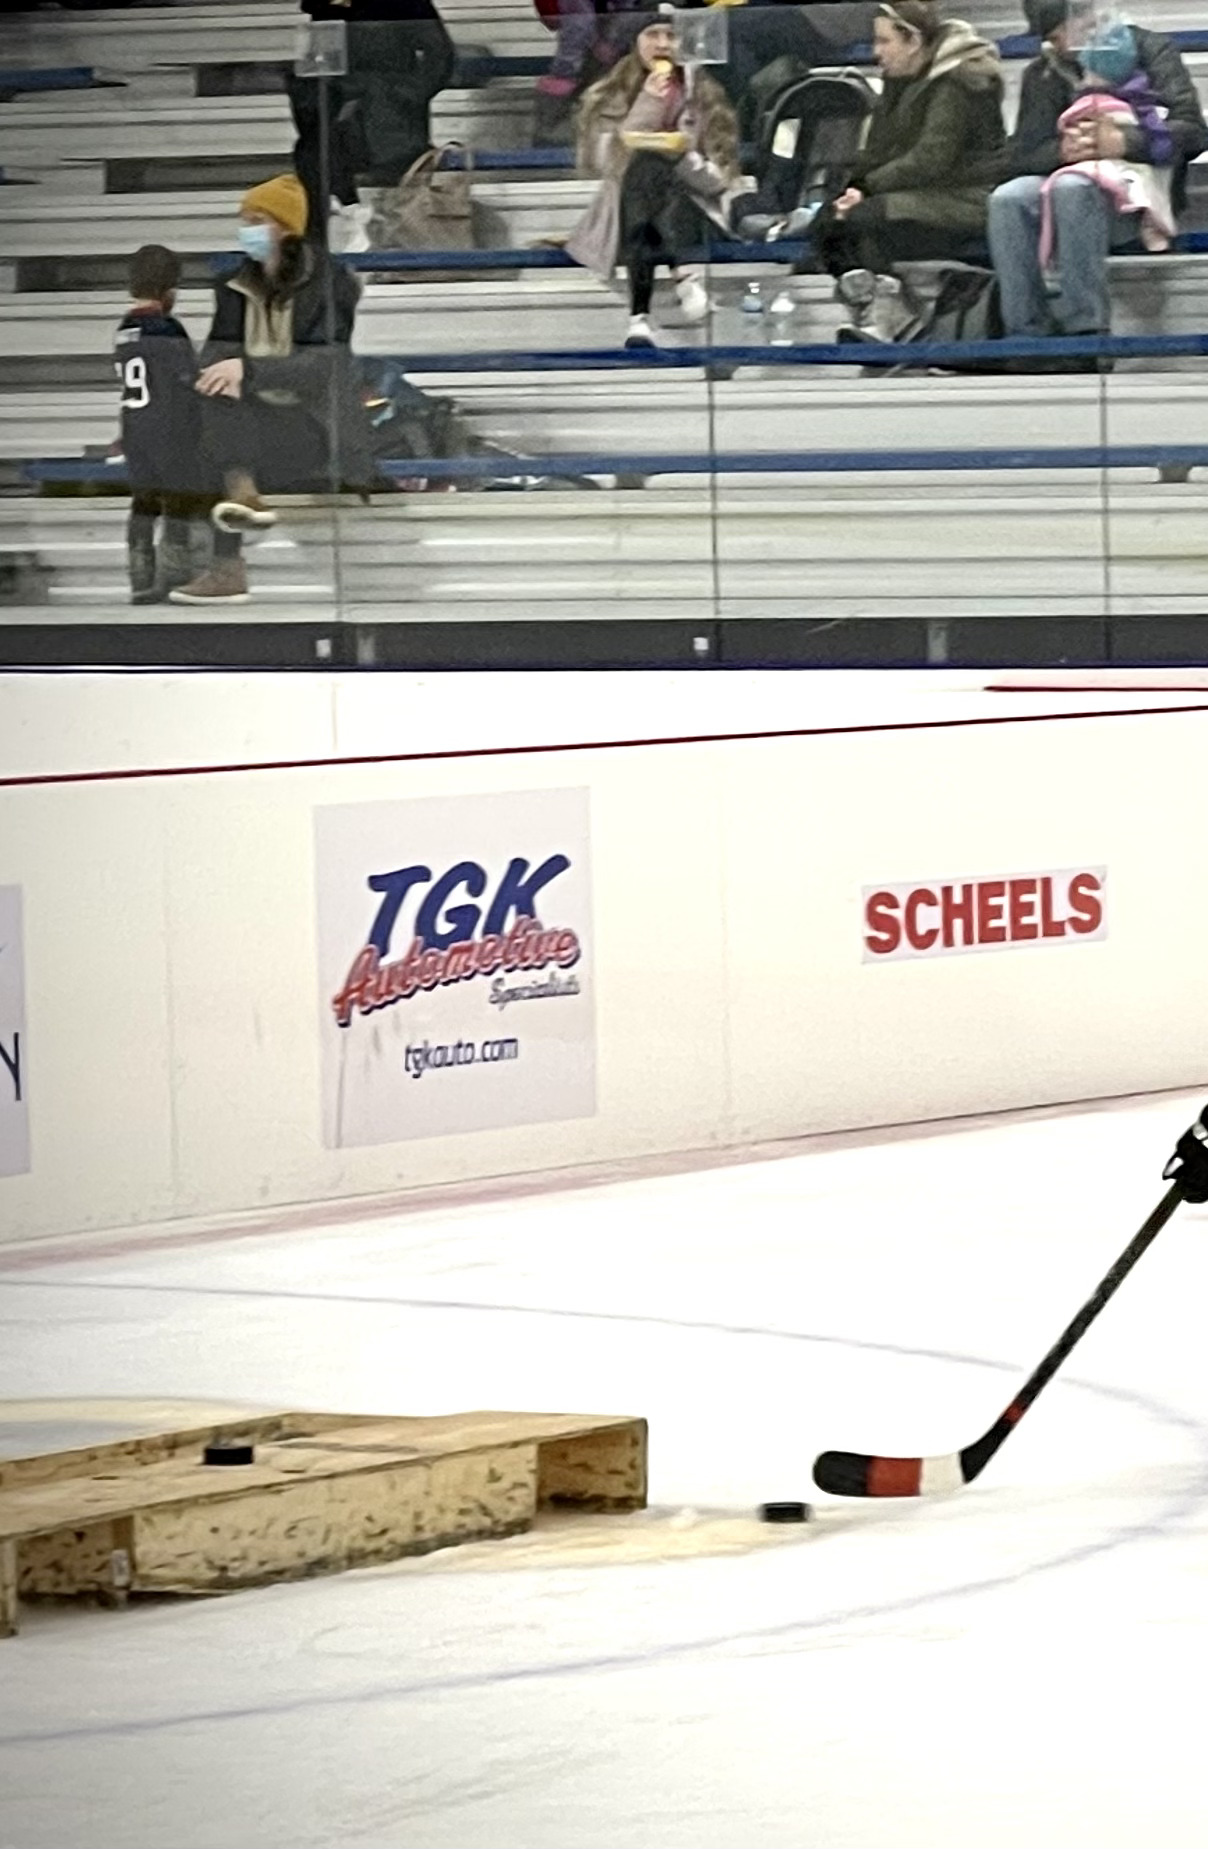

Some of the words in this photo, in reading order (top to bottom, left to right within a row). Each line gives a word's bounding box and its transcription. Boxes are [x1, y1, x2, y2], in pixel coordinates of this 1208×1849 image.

[114, 356, 150, 409] 9
[367, 854, 571, 958] TGK
[864, 872, 1104, 954] SCHEELS
[332, 914, 581, 1028] Automotive
[404, 1038, 518, 1078] tgkauto.com
